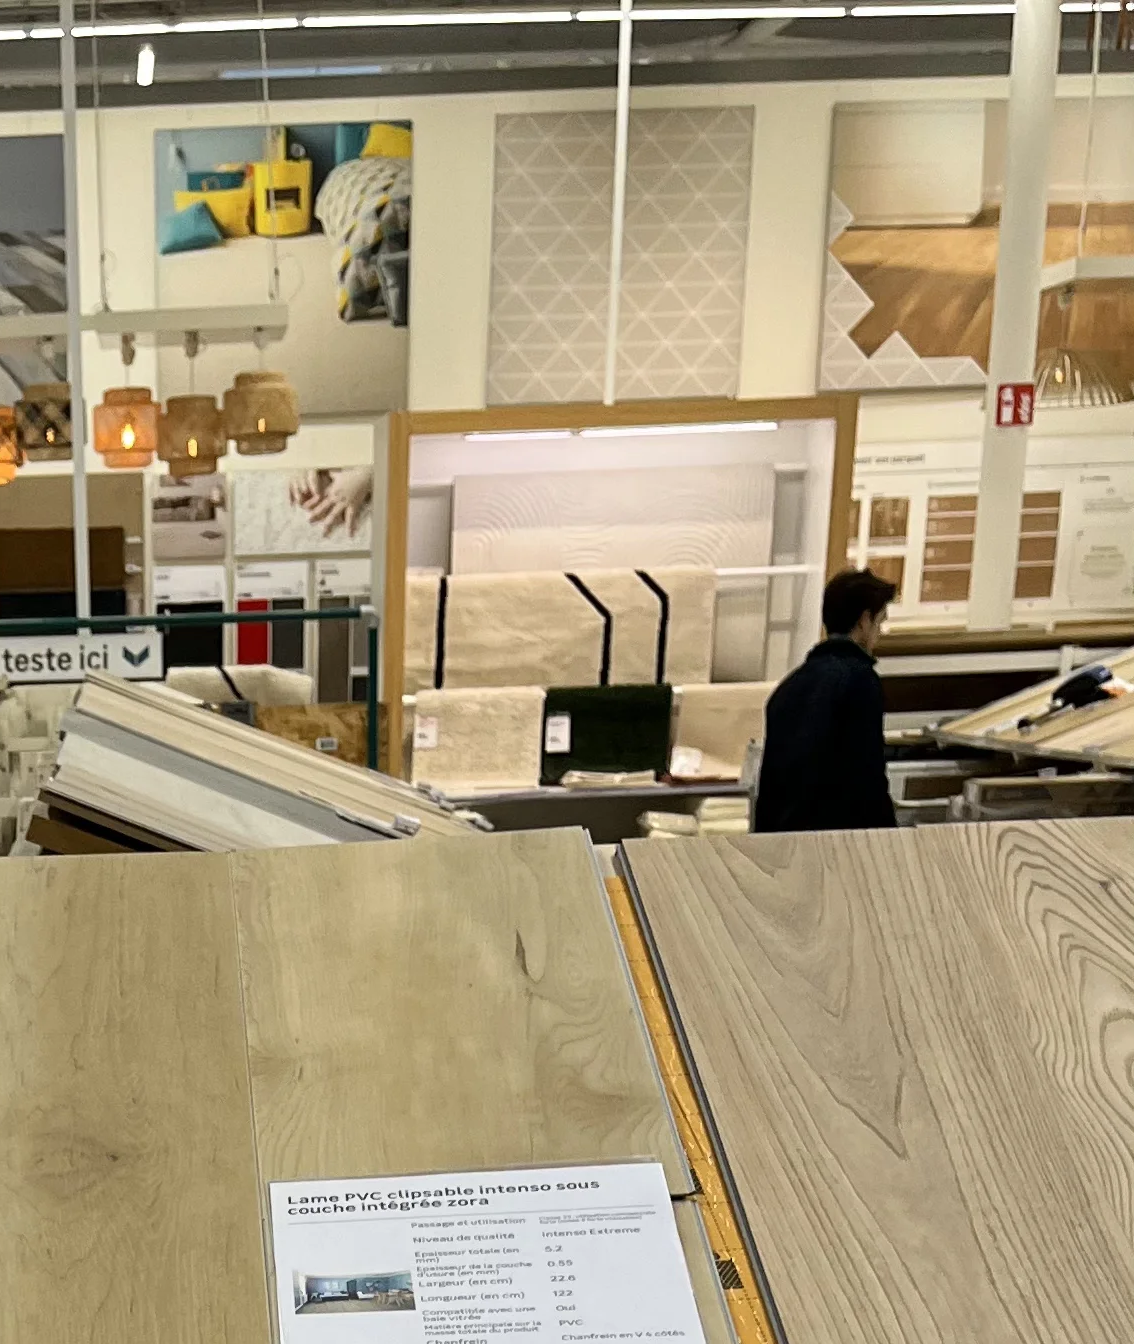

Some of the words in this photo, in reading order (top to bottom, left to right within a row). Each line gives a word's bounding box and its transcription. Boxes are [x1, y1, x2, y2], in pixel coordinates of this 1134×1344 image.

[3, 647, 72, 673] teste
[79, 644, 109, 671] ici
[288, 1193, 339, 1205] Lame
[345, 1191, 383, 1202] PVC
[387, 1185, 474, 1200] clipsable
[479, 1183, 551, 1196] intenso
[556, 1180, 600, 1192] sous
[287, 1203, 356, 1216] couche
[361, 1198, 442, 1212] intégrée
[447, 1197, 489, 1207] zora
[413, 1236, 453, 1244] Niveau
[552, 1289, 573, 1297] 122
[558, 1319, 584, 1327] PVC
[561, 1332, 617, 1342] Chanfrein
